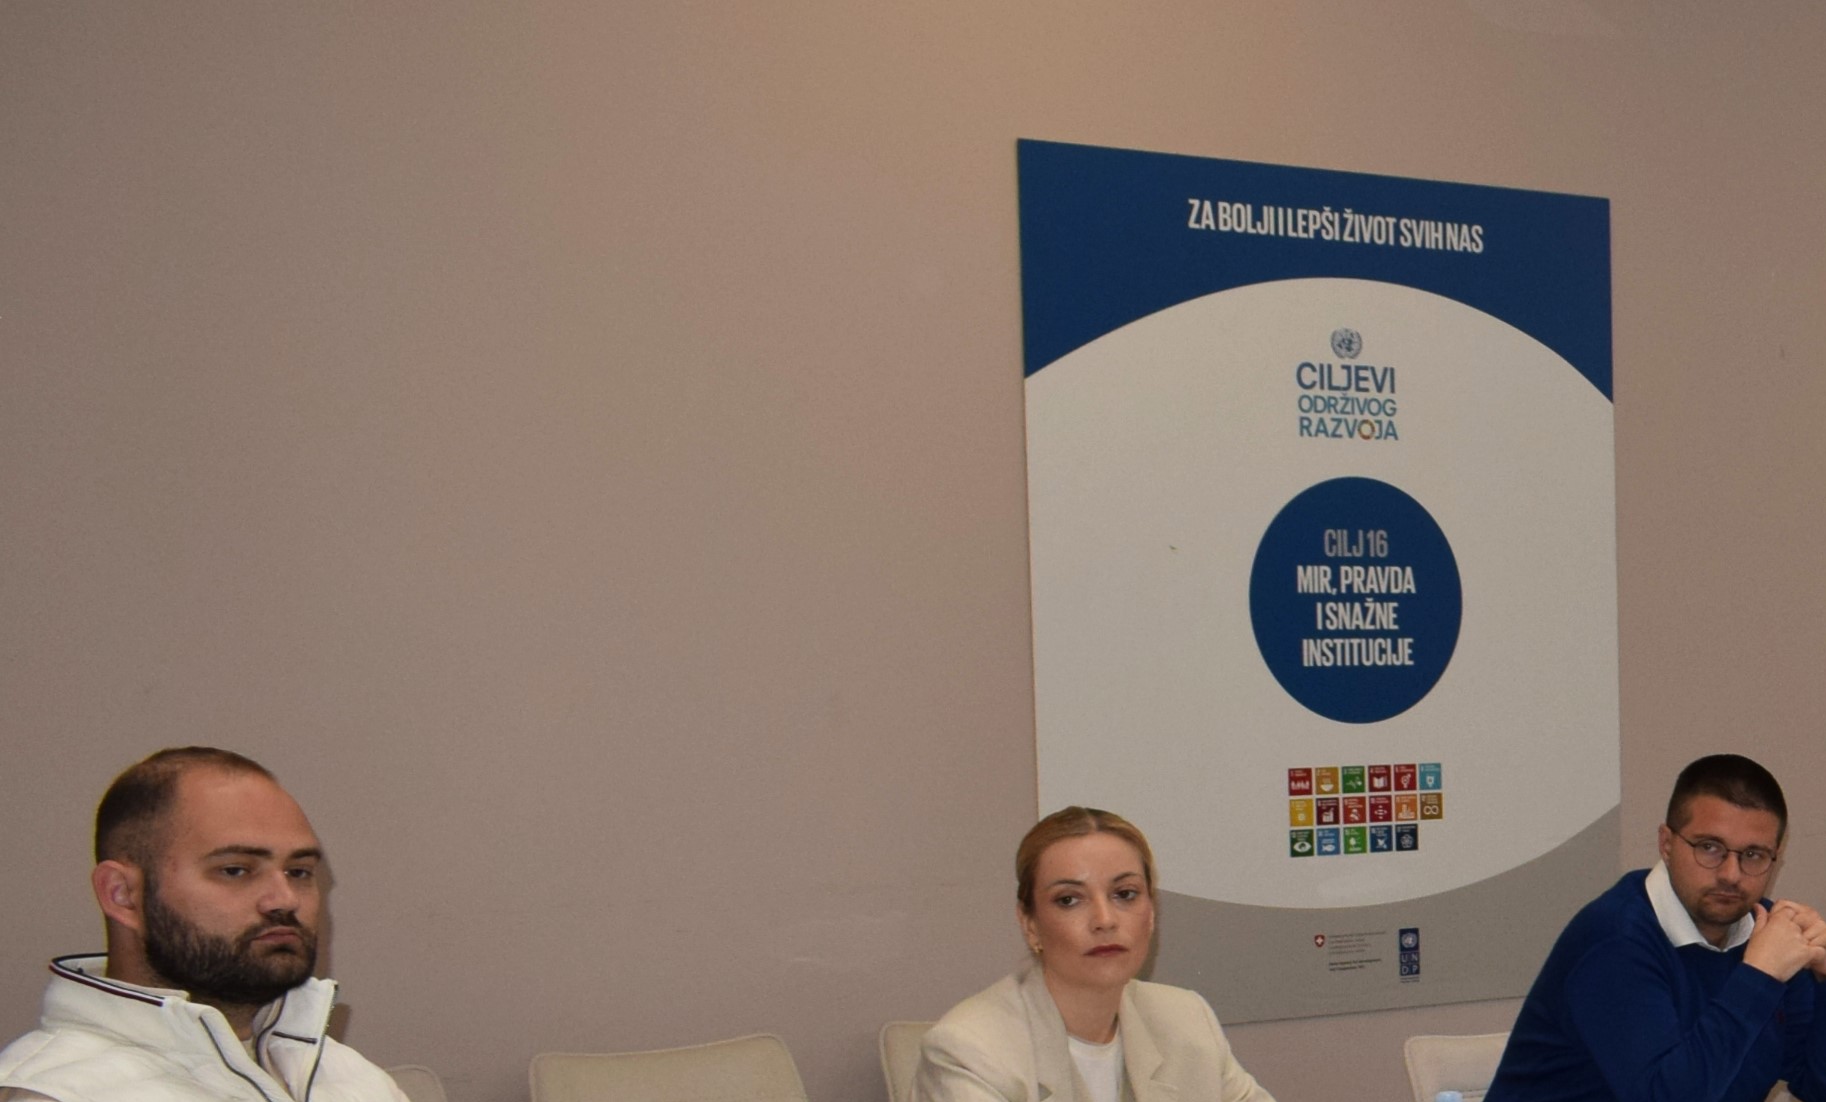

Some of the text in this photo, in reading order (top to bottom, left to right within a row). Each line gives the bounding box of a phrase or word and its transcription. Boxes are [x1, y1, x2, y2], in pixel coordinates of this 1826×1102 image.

[1187, 198, 1484, 253] ZA BOLJI I LEPŠI ŽIVOT SVIH NAS
[1296, 362, 1395, 394] CILJEVI
[1298, 393, 1397, 417] ODRŽIVOG
[1298, 416, 1399, 441] RAZVOJA
[1323, 528, 1389, 558] CILJ 16
[1296, 565, 1417, 595] MIR, PRAVDA
[1316, 598, 1399, 630] I SNAŽNE
[1302, 638, 1415, 667] INSTITUCIJE
